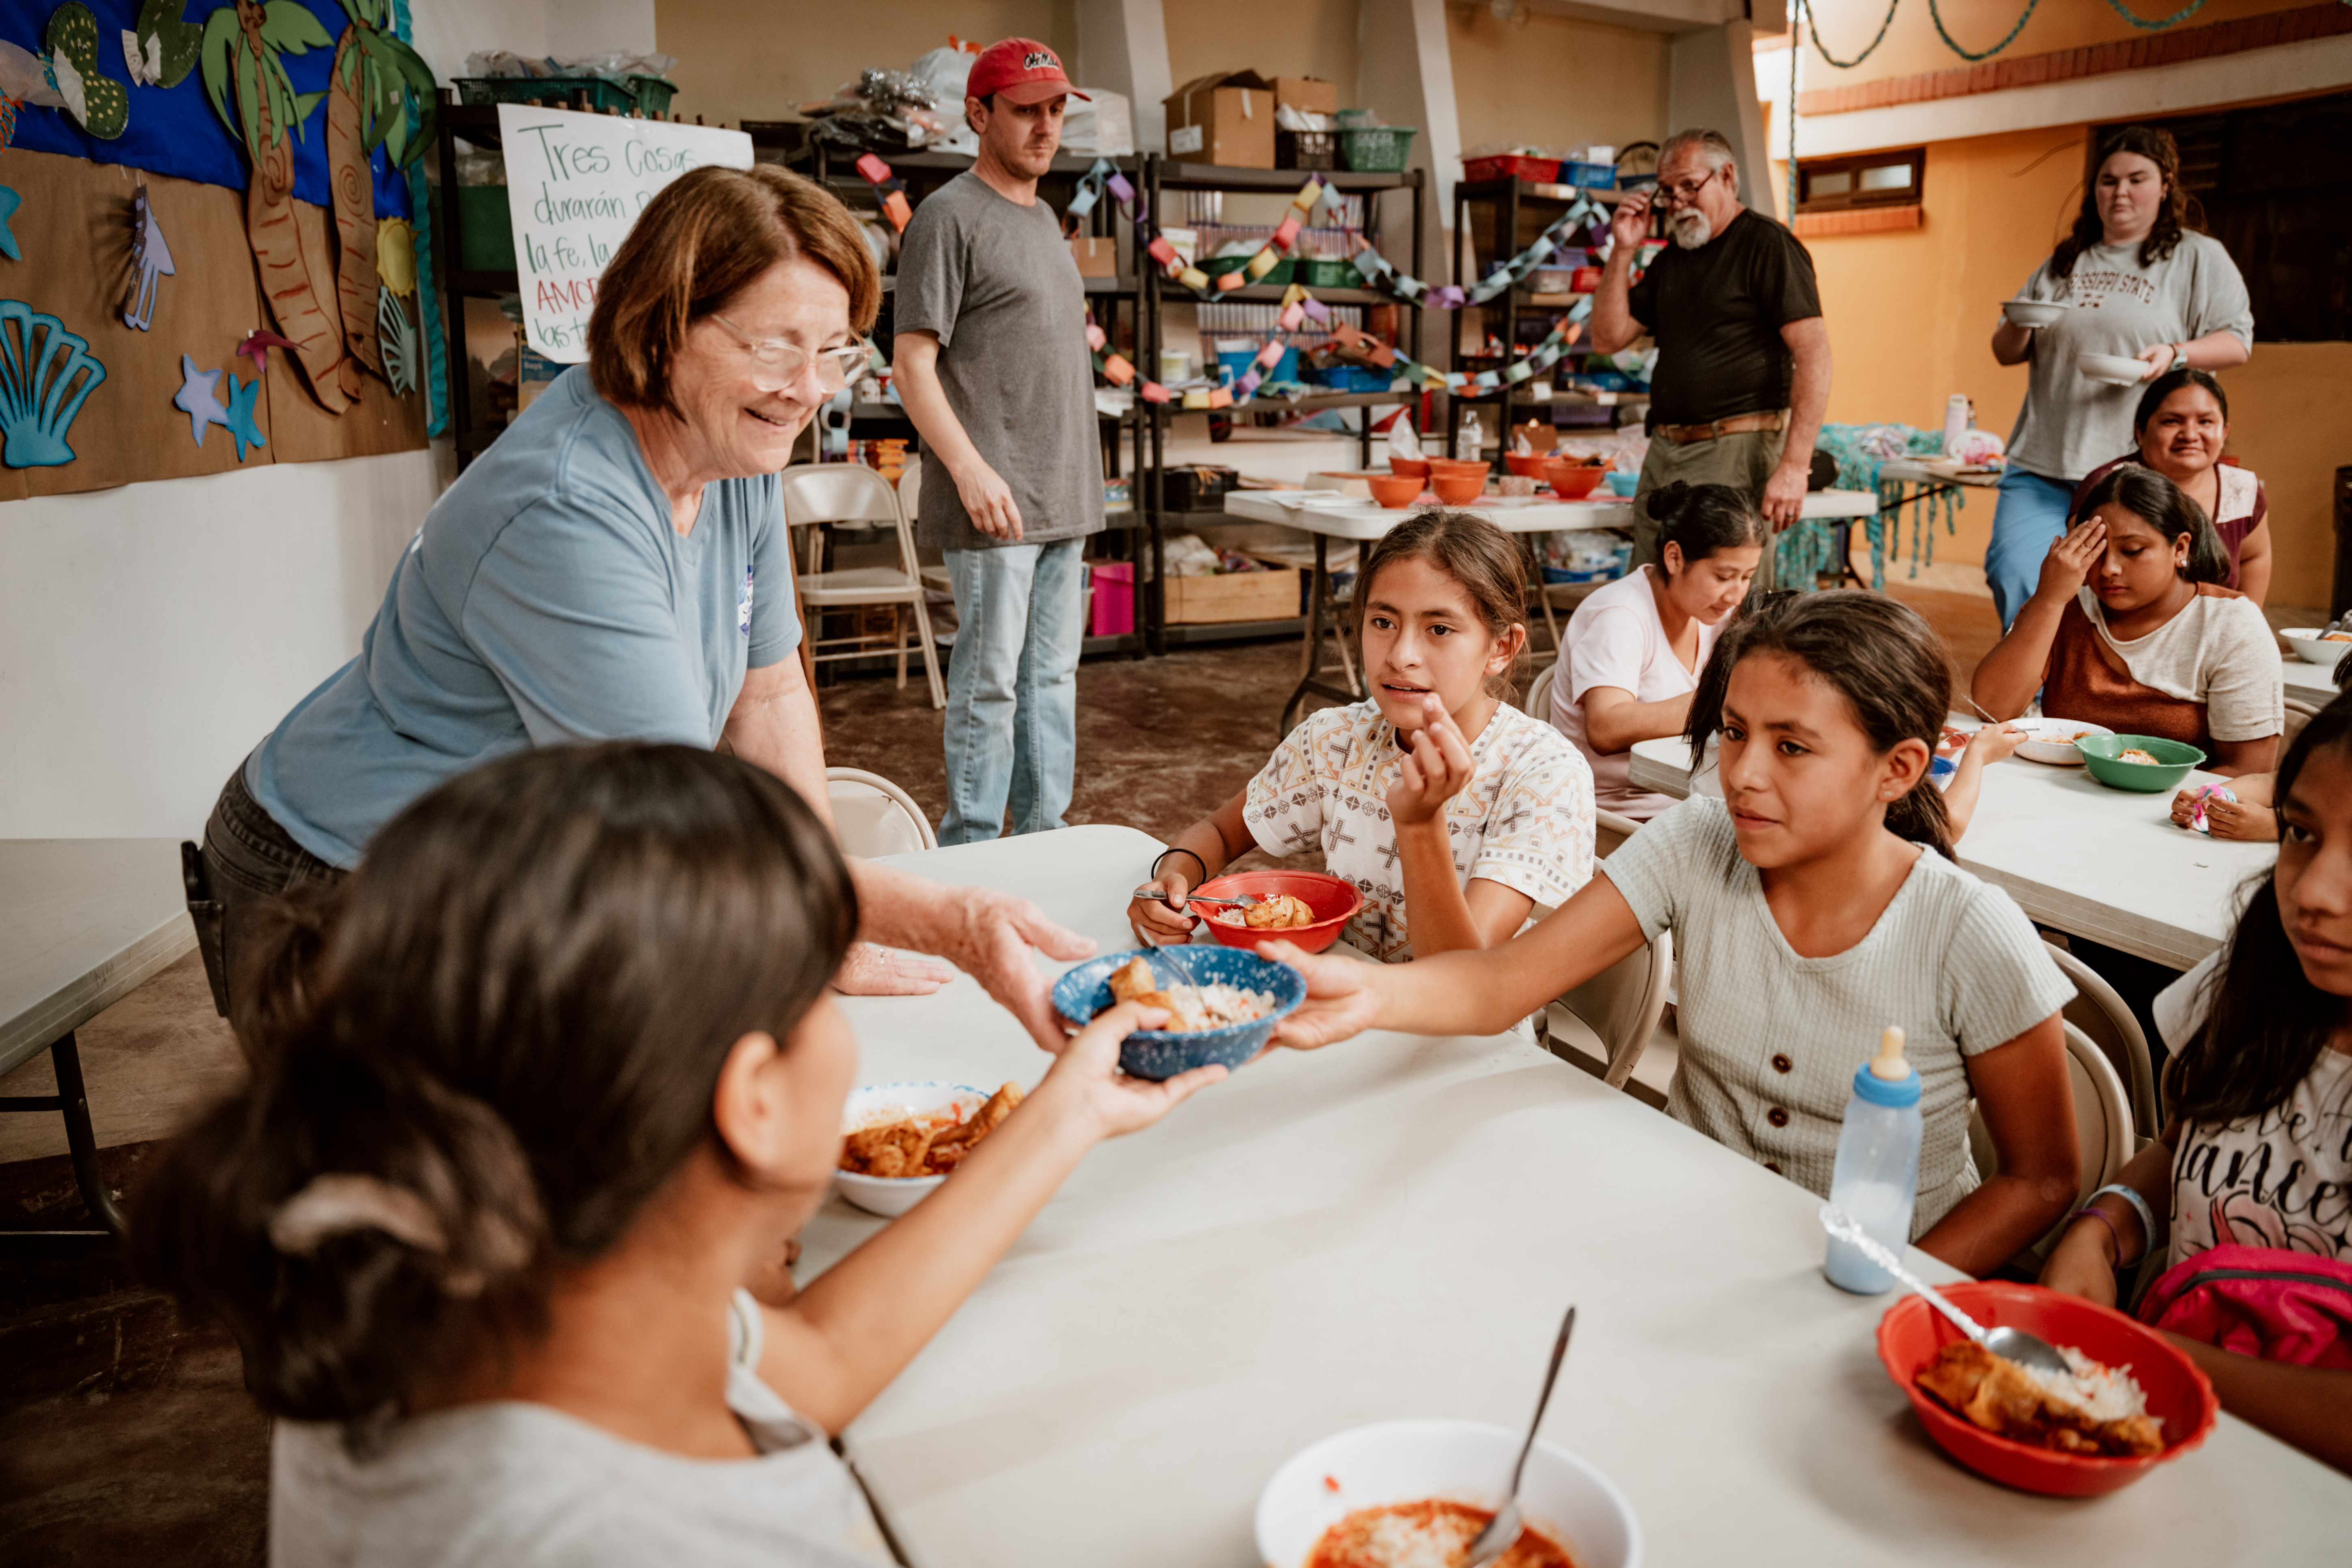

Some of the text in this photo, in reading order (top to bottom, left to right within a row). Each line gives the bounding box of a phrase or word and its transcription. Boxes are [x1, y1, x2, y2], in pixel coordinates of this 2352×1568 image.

[517, 124, 610, 181] Tres
[534, 181, 626, 225] durarán
[525, 233, 611, 274] la fe, la
[2118, 273, 2155, 304] STATE
[534, 318, 570, 349] las
